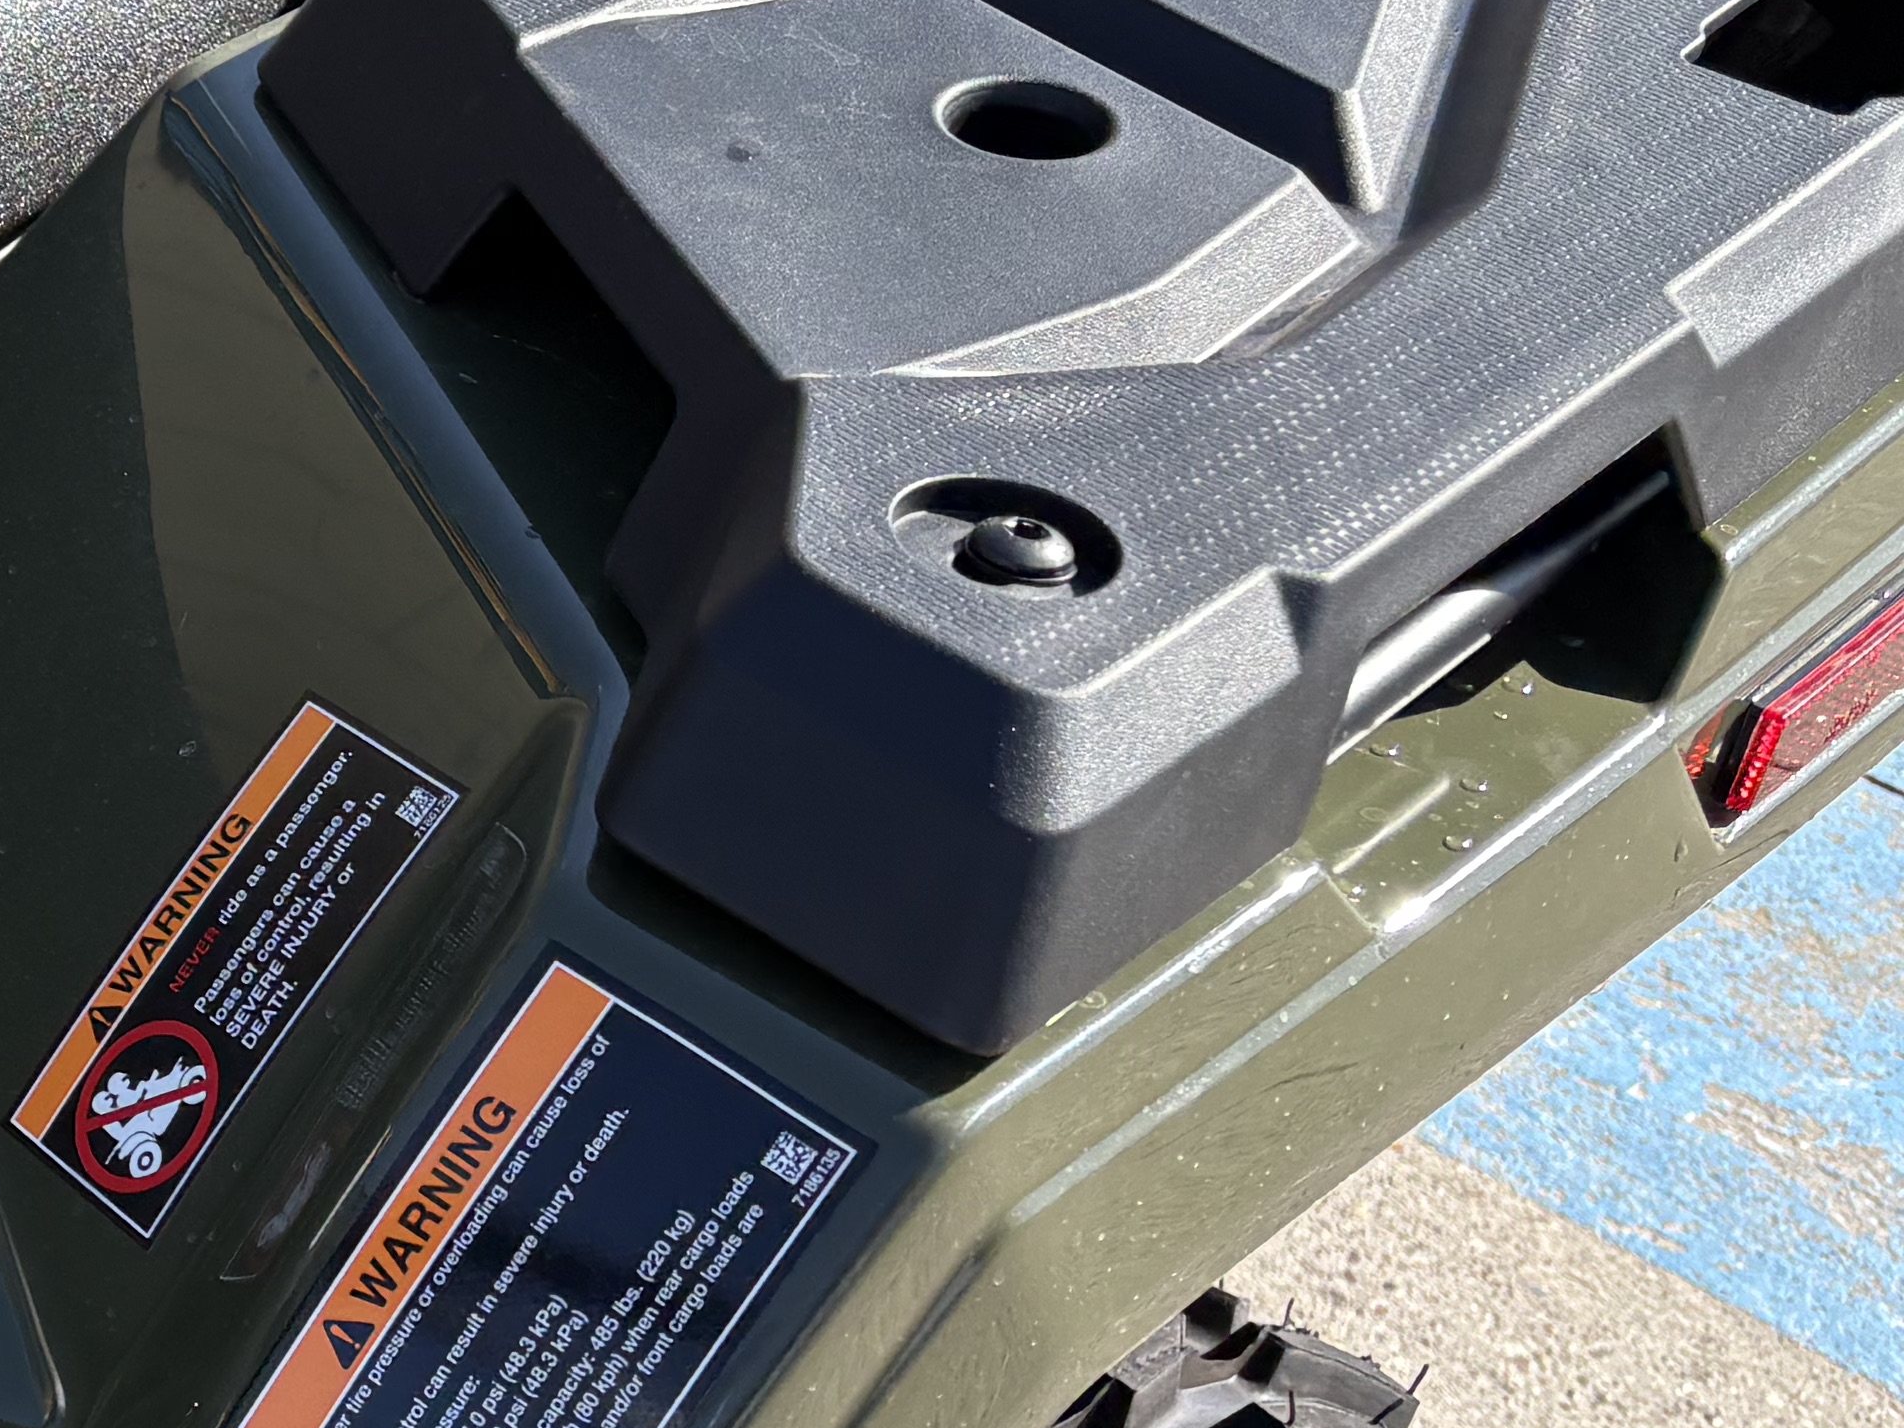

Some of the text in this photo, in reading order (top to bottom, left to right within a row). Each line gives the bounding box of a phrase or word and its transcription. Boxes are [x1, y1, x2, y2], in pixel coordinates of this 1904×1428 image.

[108, 813, 252, 994] WARNING
[168, 751, 354, 994] NEVER ride as a passenger.
[193, 799, 357, 1015] Passengers can cause a
[208, 791, 387, 1027] loss of control, resulting in
[225, 861, 355, 1038] SEVERE INJURY or
[240, 980, 299, 1051] DEATH.
[344, 1383, 373, 1415] tire
[367, 1307, 423, 1387] pressure
[417, 1283, 436, 1308] or
[432, 1183, 509, 1287] overloading
[501, 1149, 531, 1185] can
[525, 1095, 569, 1150] cause
[559, 1057, 596, 1096] loss
[590, 1032, 611, 1057] of
[349, 1096, 517, 1308] WARNING
[422, 1364, 453, 1400] can
[445, 1312, 486, 1366] result
[475, 1294, 499, 1315] in
[492, 1234, 539, 1295] severe
[529, 1183, 575, 1235] injury
[568, 1160, 589, 1184] or
[583, 1108, 630, 1163] death.
[572, 1391, 600, 1424] (80
[590, 1352, 630, 1395] kph)
[620, 1306, 660, 1354] when
[653, 1268, 684, 1307] rear
[679, 1219, 720, 1271] cargo
[710, 1170, 755, 1221] loads
[589, 1314, 620, 1352] 485
[610, 1286, 645, 1318] lbs.
[635, 1239, 672, 1283] (220
[663, 1208, 696, 1242] kg)
[635, 1331, 675, 1376] front
[668, 1282, 709, 1334] cargo
[699, 1233, 743, 1284] loads
[737, 1203, 764, 1235] are
[481, 1379, 508, 1416] psi
[498, 1335, 537, 1385] (48.3
[527, 1293, 569, 1339] kPa)
[520, 1350, 559, 1399] (48.3
[549, 1308, 590, 1353] kPa)
